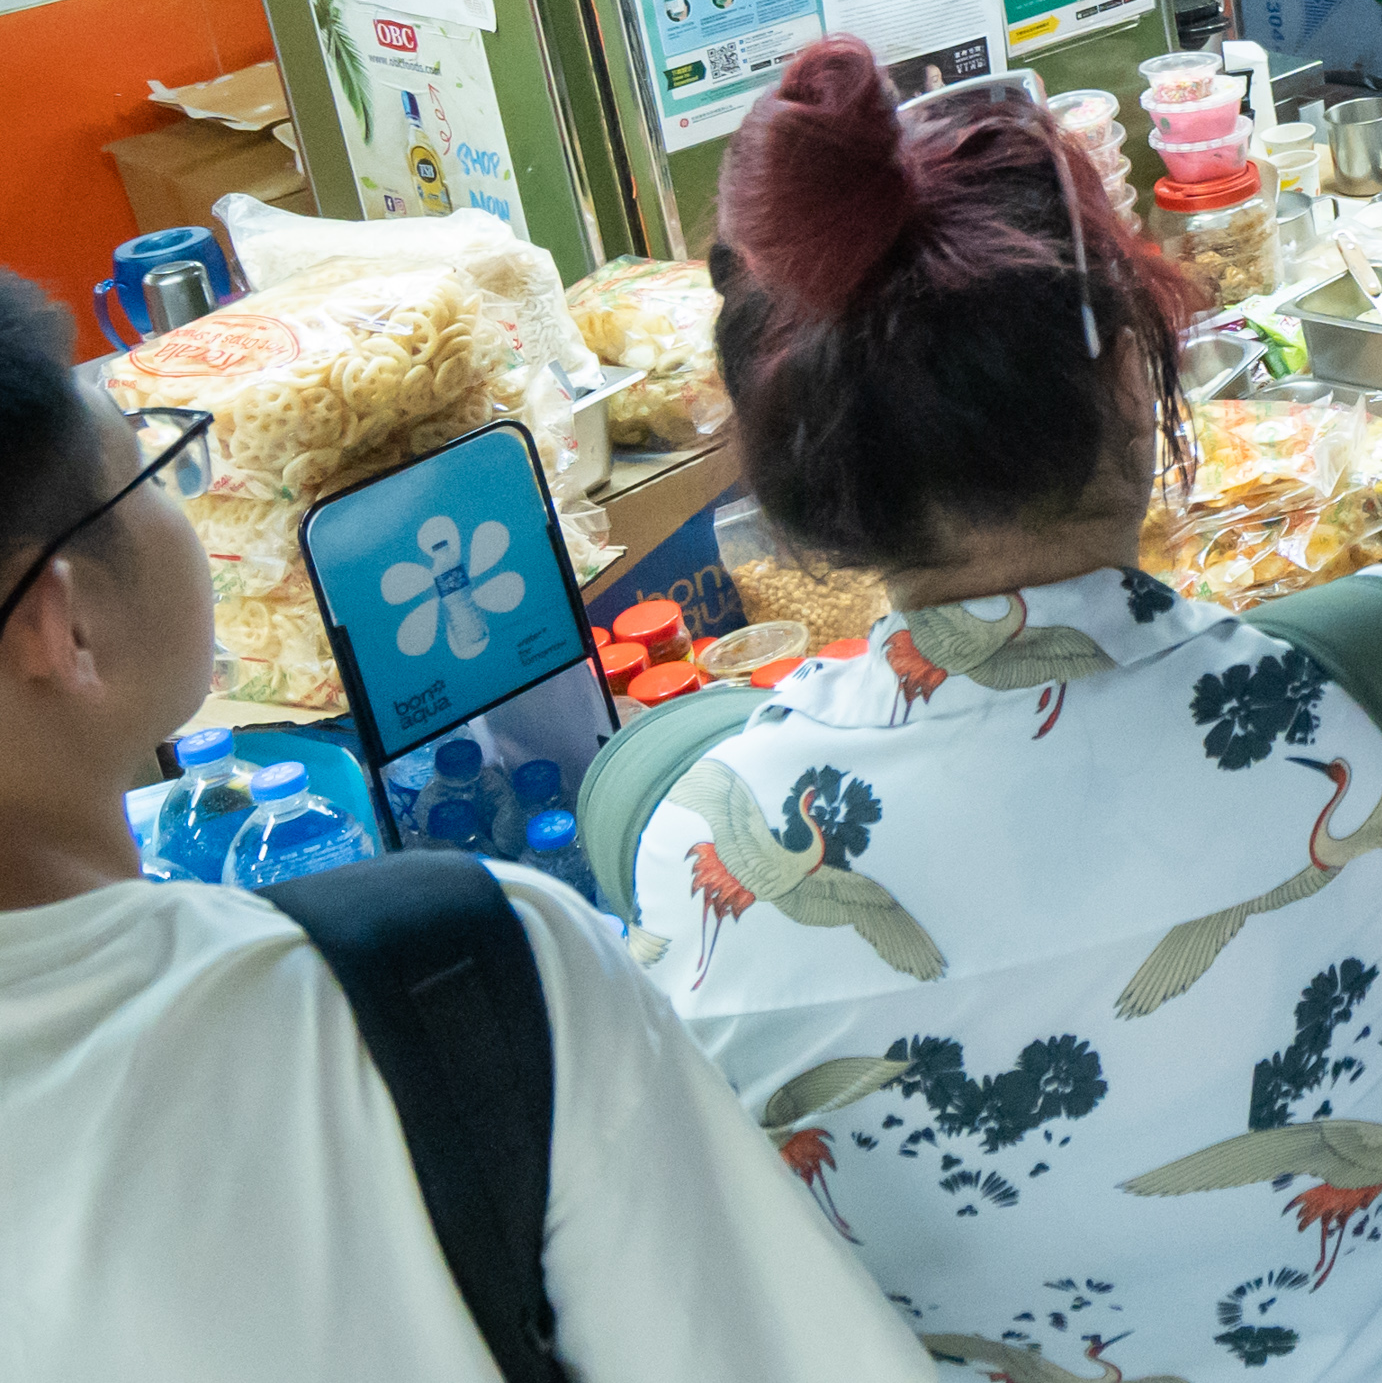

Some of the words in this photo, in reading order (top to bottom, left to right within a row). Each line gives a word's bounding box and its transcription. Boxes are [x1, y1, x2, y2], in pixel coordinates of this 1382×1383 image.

[376, 22, 415, 49] OBC
[456, 142, 501, 179] SHOP
[469, 190, 511, 220] NOW
[211, 332, 222, 344] &
[222, 333, 259, 350] Chips
[259, 340, 289, 356] Hot
[154, 342, 247, 371] Kerala
[393, 689, 433, 717] bon
[400, 696, 453, 731] aqua
